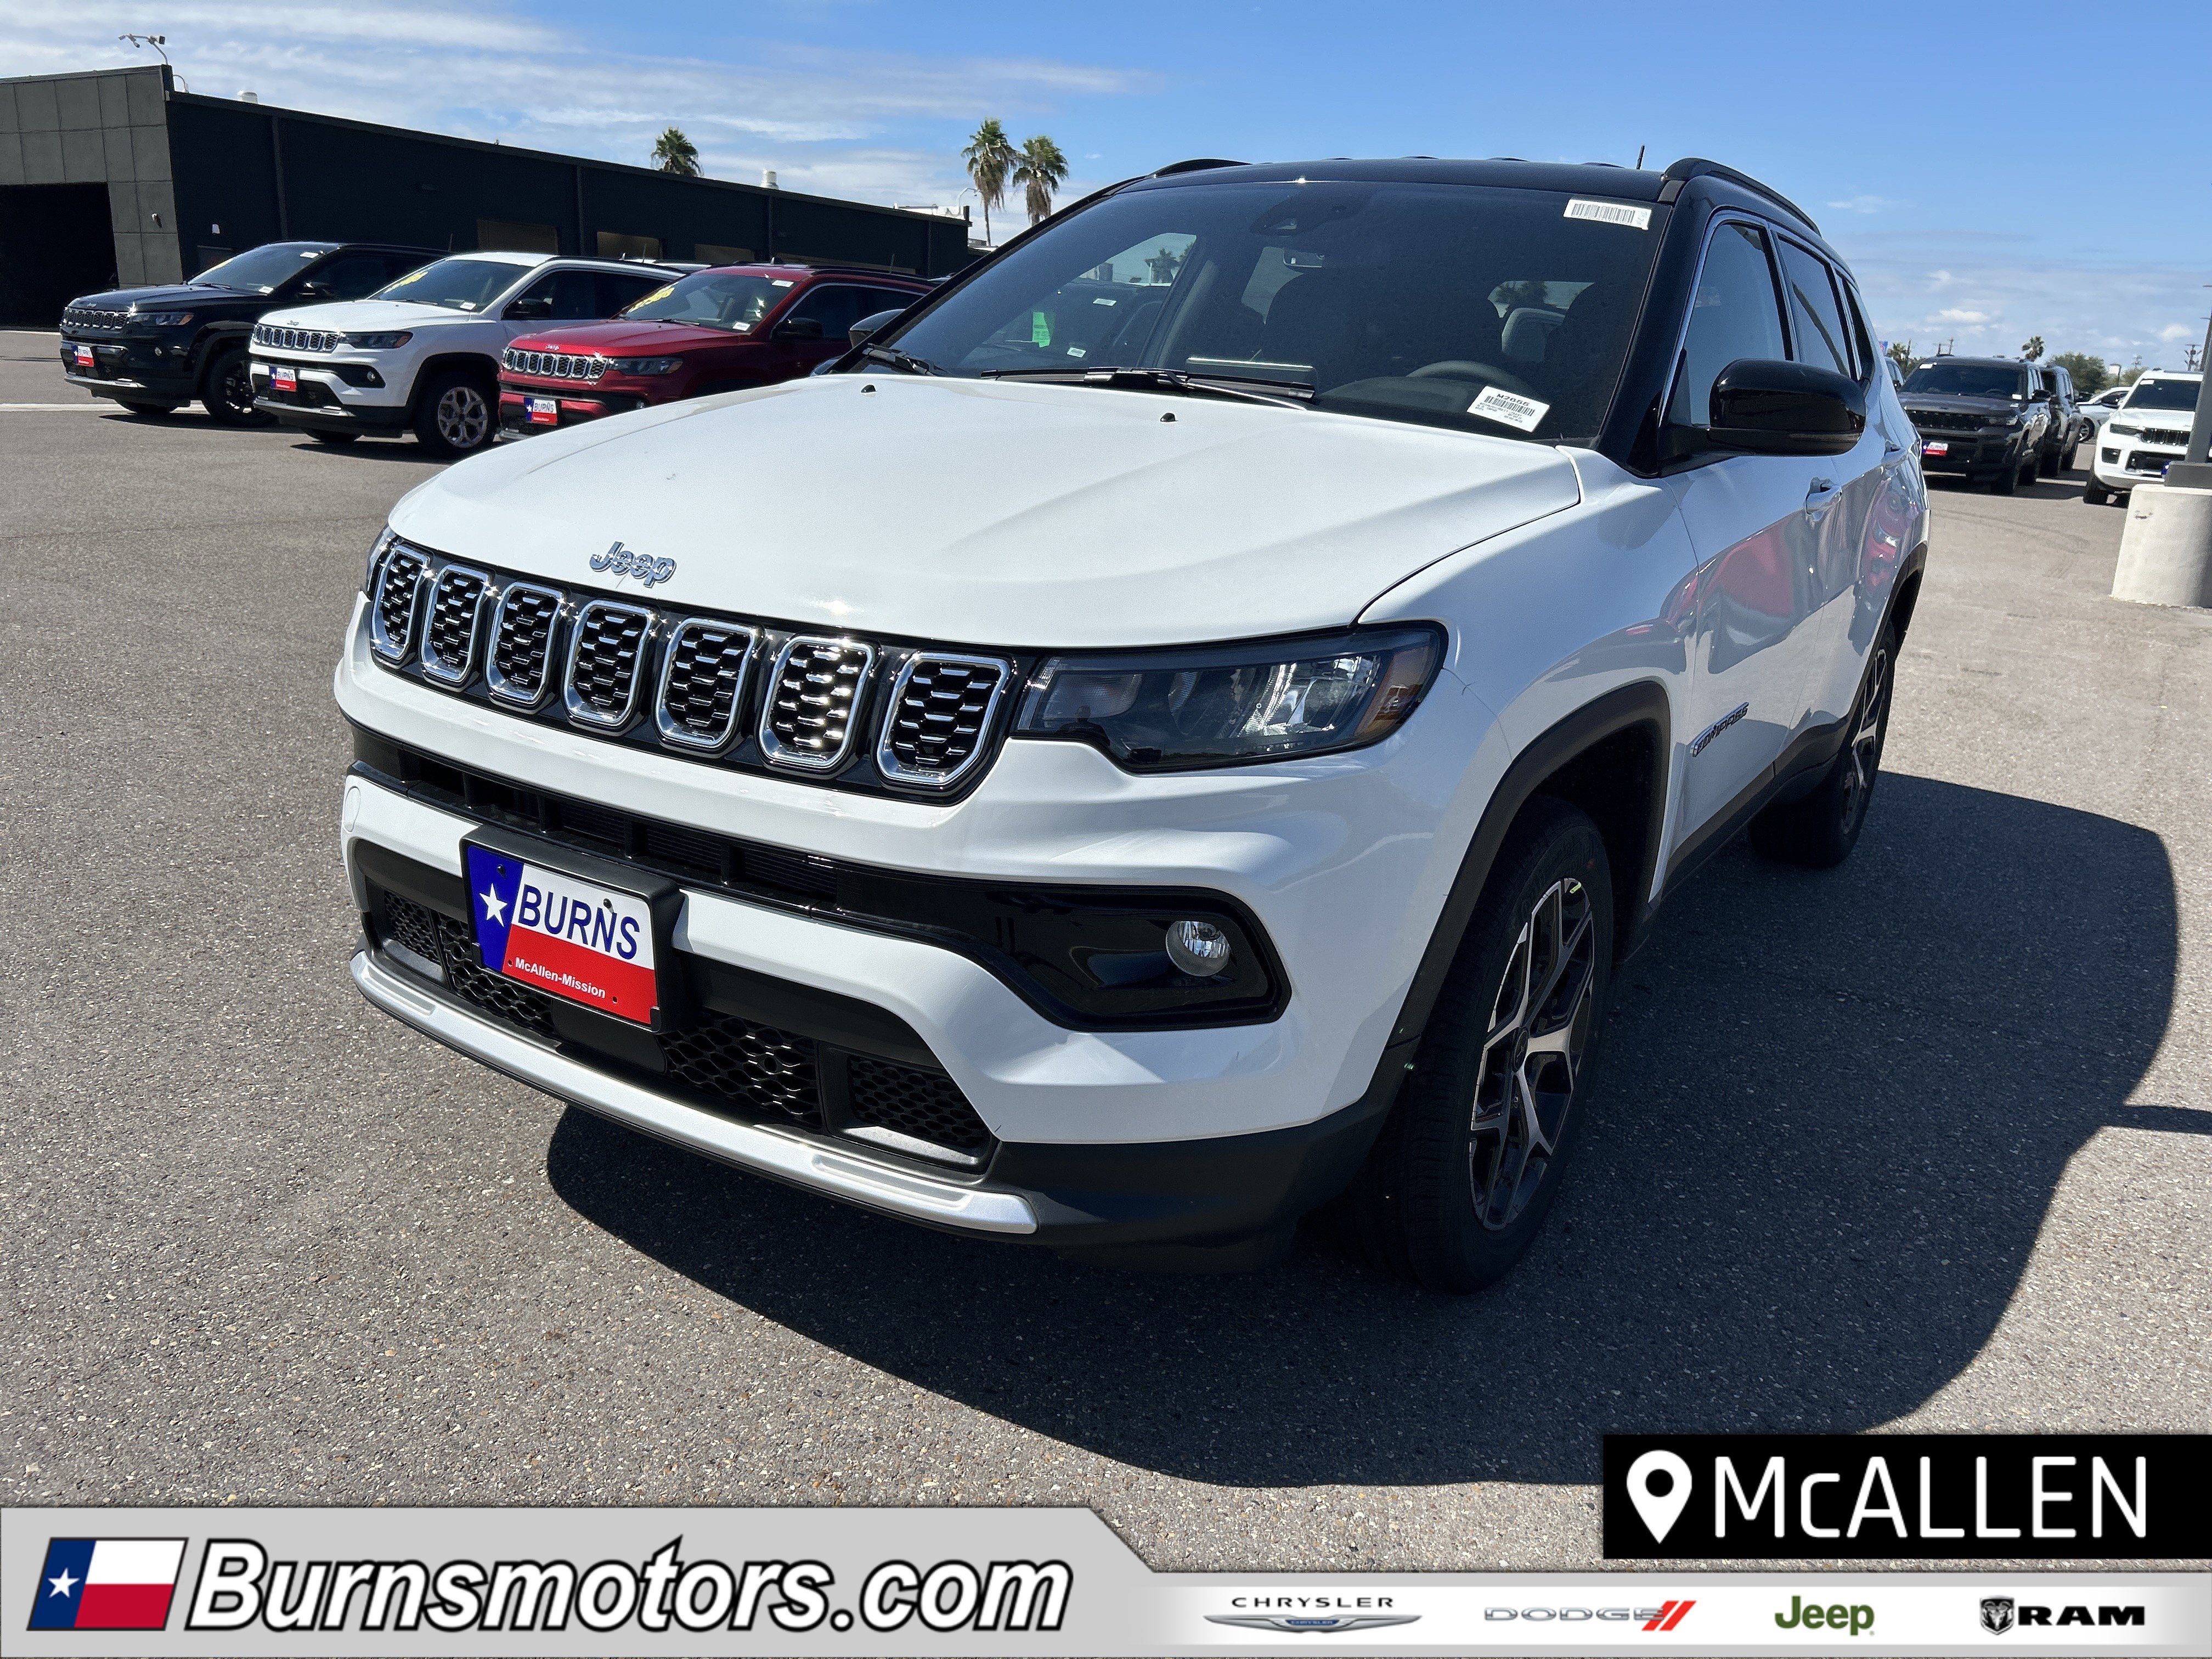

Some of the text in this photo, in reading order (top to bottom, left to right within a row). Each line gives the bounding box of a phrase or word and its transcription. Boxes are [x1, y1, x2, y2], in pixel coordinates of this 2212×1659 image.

[534, 402, 554, 413] BURNS
[590, 541, 677, 589] Jeep
[518, 884, 640, 960] BURNS
[515, 957, 606, 998] McAllen-Mission
